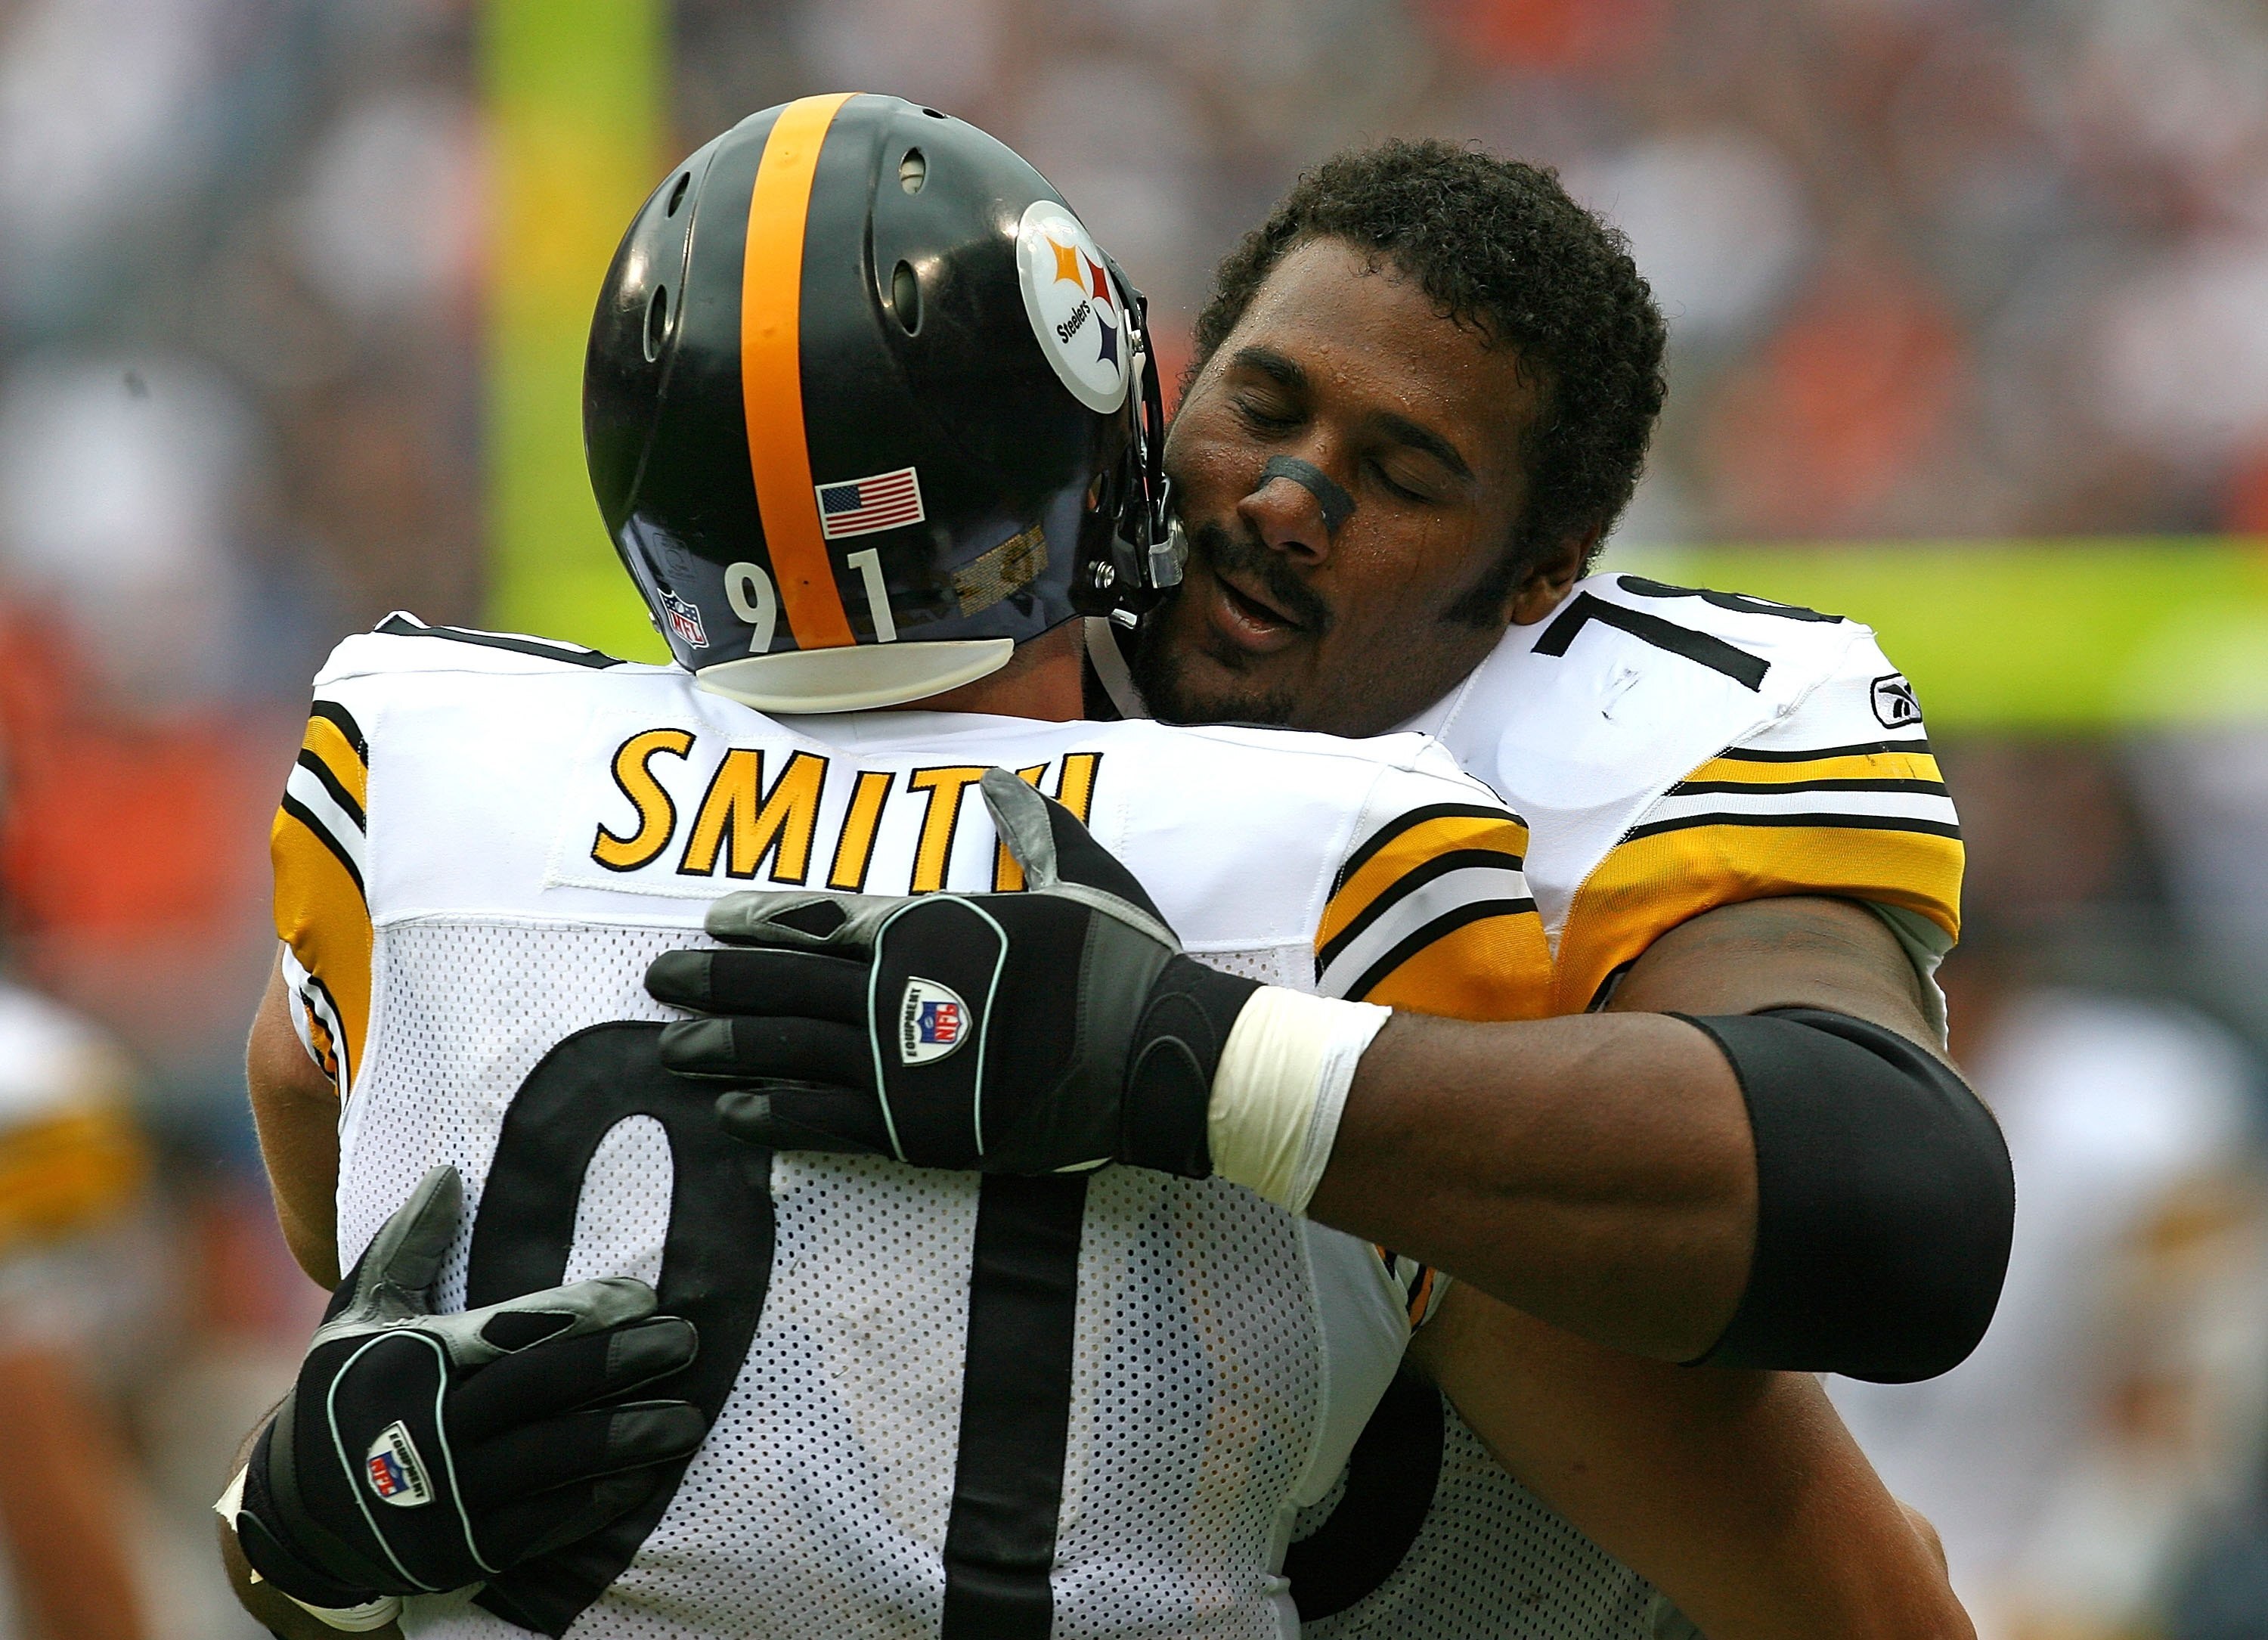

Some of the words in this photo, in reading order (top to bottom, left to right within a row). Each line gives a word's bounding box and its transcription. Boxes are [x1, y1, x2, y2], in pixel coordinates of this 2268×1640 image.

[1056, 300, 1091, 344] Steelers
[670, 610, 705, 644] NFL
[904, 987, 922, 1057] EQUIPMENT
[934, 1003, 959, 1041] NFL
[370, 1458, 397, 1496] NFL
[389, 1433, 426, 1499] EQUIPMENT
